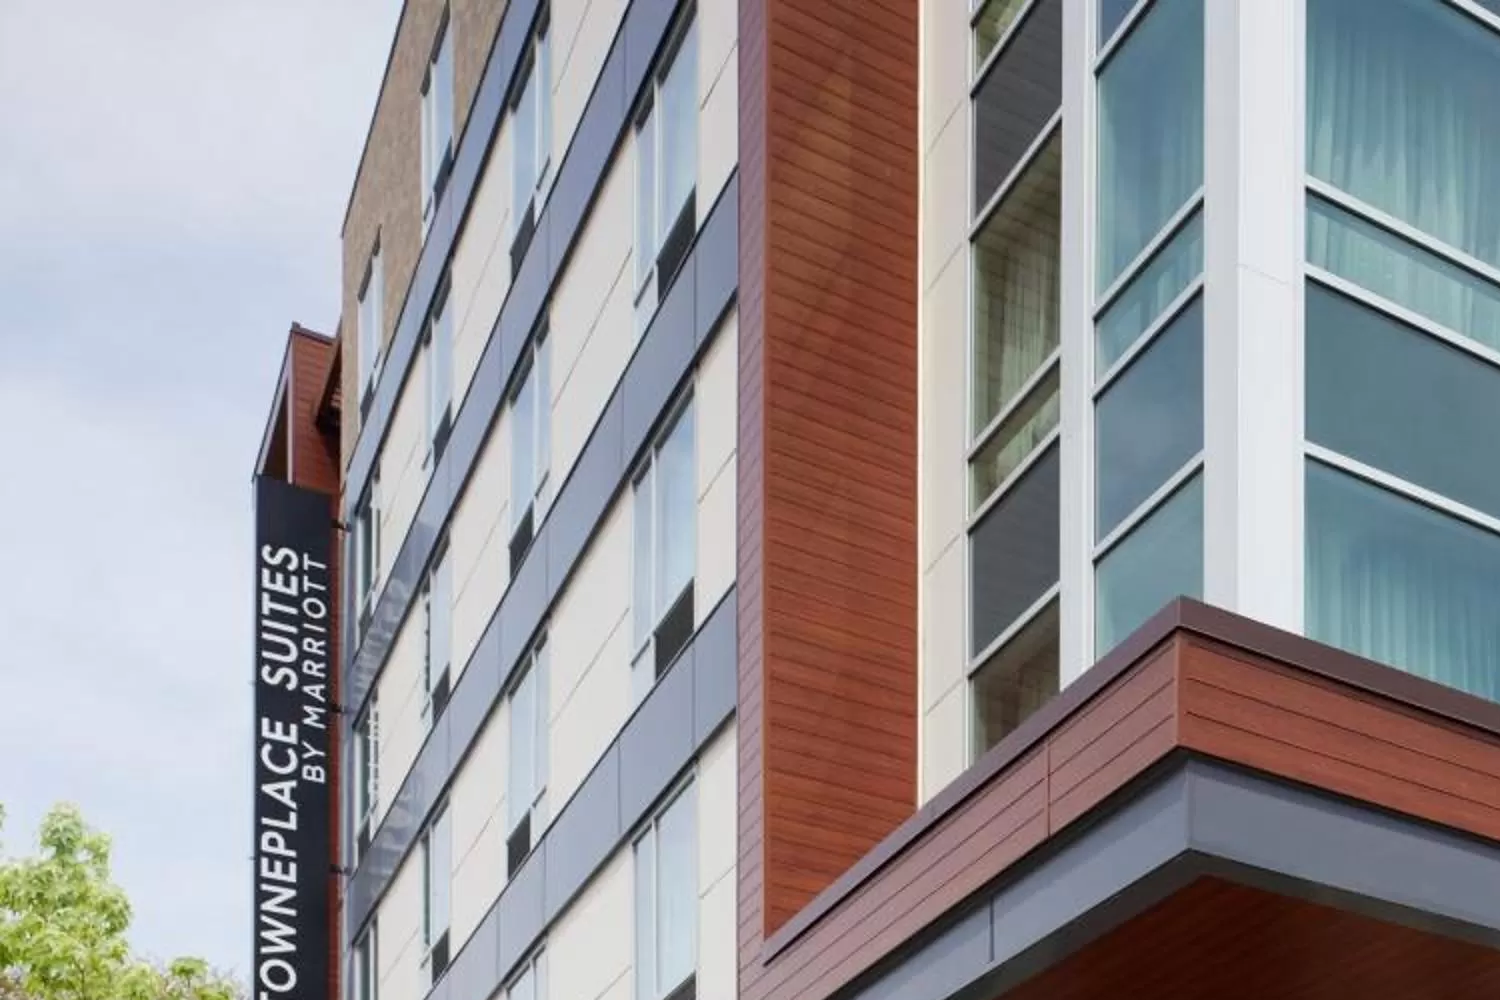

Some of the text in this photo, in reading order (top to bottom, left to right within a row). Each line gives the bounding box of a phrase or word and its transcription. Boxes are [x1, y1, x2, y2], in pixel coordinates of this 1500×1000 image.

[261, 544, 299, 691] SUITES
[302, 552, 327, 784] BY MARRIOTT
